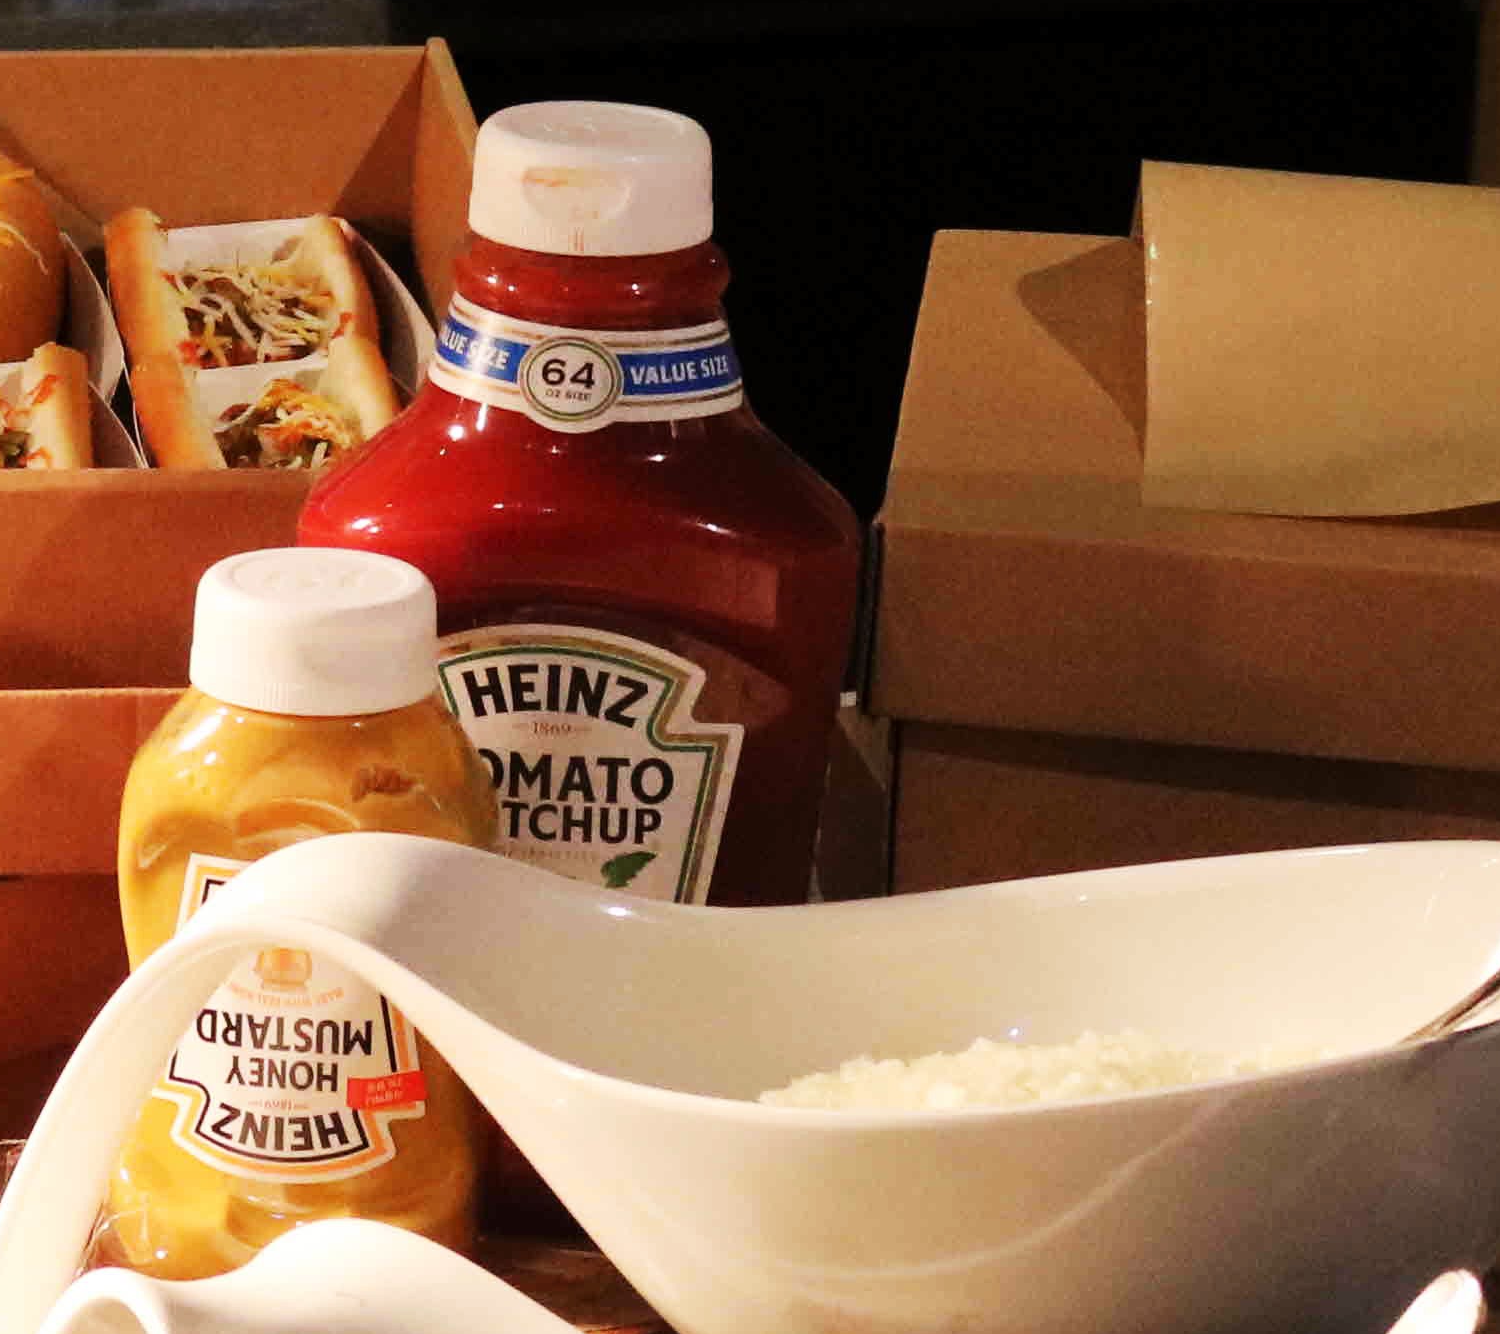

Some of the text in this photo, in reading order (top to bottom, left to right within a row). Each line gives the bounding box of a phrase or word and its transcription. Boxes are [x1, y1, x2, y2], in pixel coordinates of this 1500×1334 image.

[469, 335, 509, 370] SIZE
[542, 358, 596, 389] 64
[630, 354, 729, 385] VALUE SIZE
[461, 663, 649, 729] HEINZ
[478, 747, 675, 805] OMATO
[502, 800, 662, 845] TCHUP
[196, 1008, 373, 1056] MUSTARD
[226, 1055, 339, 1093] HONEY
[211, 1102, 350, 1152] HEINZ
